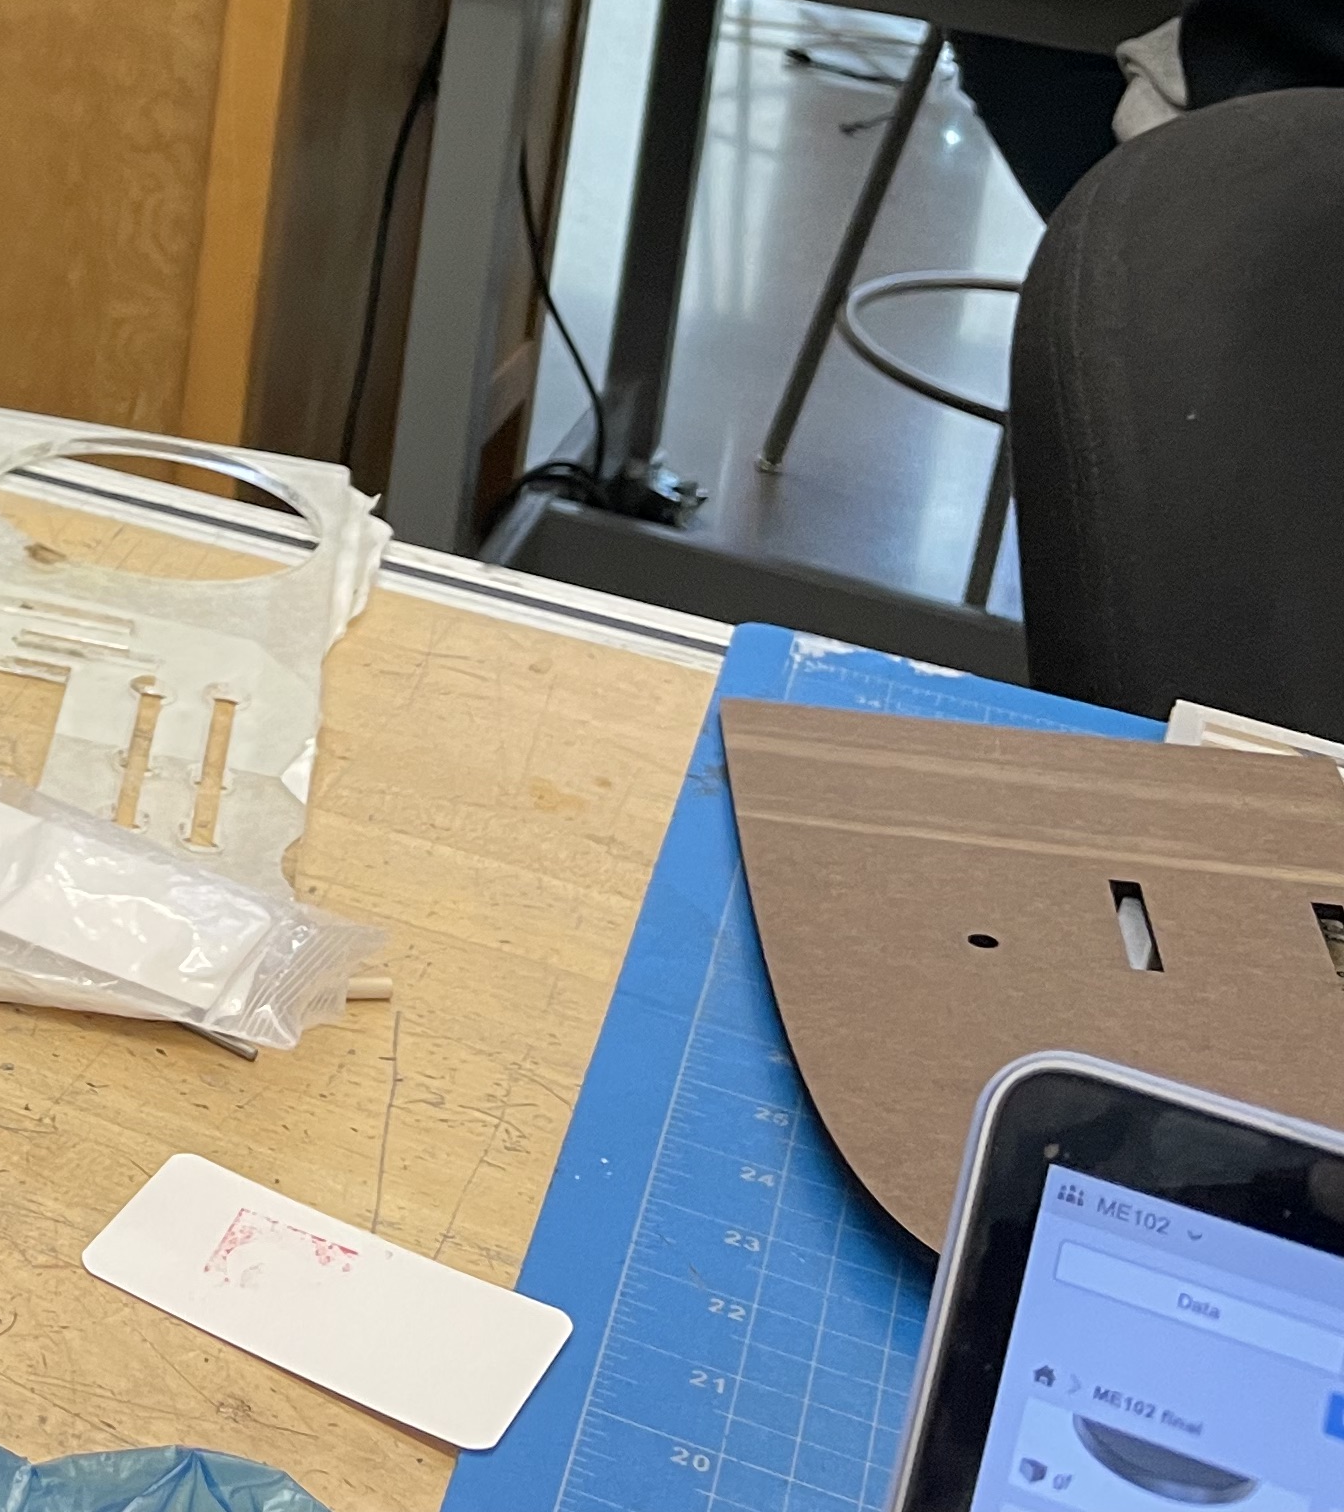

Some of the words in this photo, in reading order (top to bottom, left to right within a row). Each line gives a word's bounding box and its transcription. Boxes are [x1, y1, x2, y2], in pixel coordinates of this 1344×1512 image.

[739, 1166, 775, 1187] 24
[1096, 1196, 1172, 1236] ME102
[724, 1229, 761, 1252] 23
[708, 1298, 747, 1321] 22
[1176, 1291, 1221, 1321] Data
[688, 1369, 726, 1395] 21
[1092, 1385, 1157, 1419] ME102
[670, 1446, 711, 1473] 20
